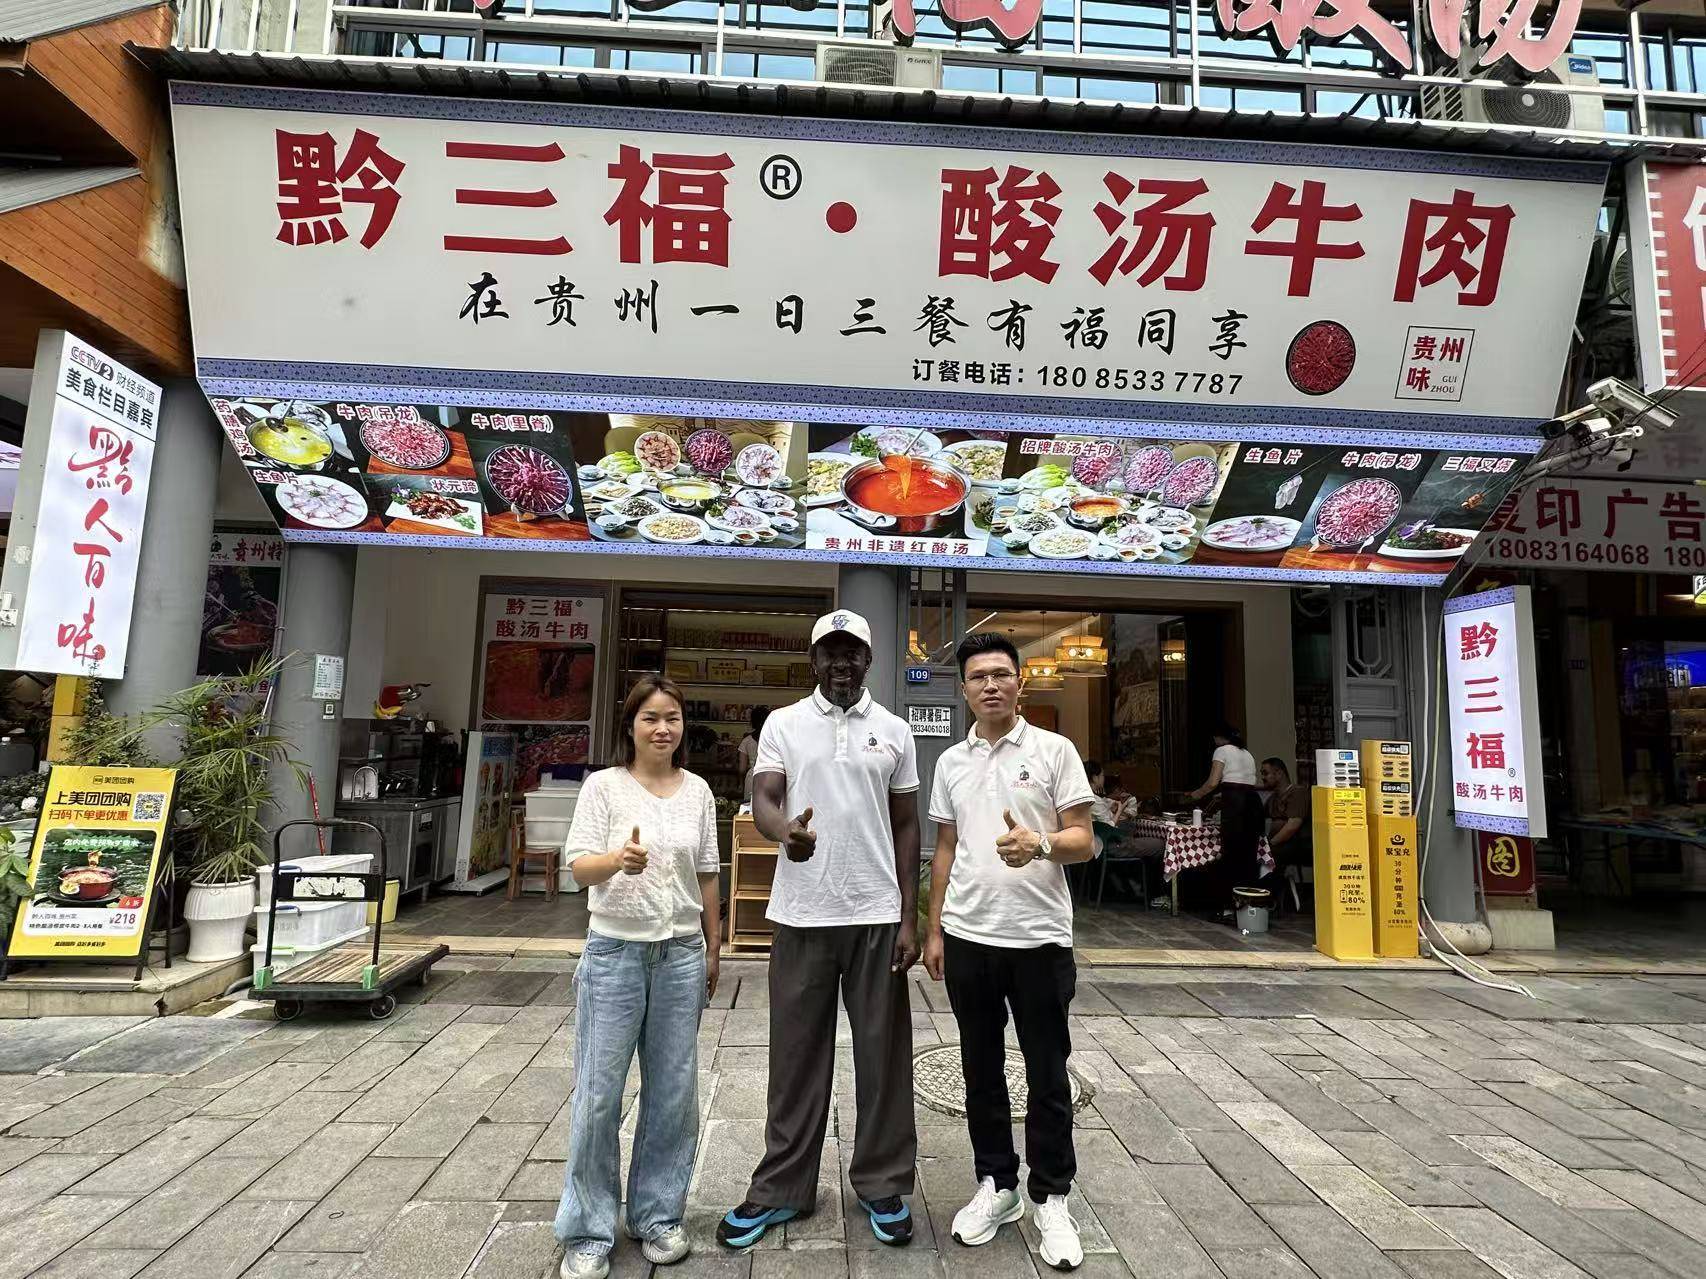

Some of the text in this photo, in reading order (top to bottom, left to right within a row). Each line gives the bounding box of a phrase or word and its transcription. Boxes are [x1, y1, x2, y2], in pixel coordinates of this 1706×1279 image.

[458, 271, 1249, 361] 在贵州一日三餐有福同享
[1411, 335, 1465, 362] 贵州
[116, 372, 156, 405] 财经频道
[1406, 367, 1431, 392] 味
[1442, 375, 1458, 383] GUI
[66, 367, 154, 430] 美食栏目嘉宾
[1430, 385, 1455, 393] ZHOU
[213, 398, 256, 456] 药膳鸡汤
[1020, 438, 1115, 458] 招牌酸汤牛肉
[1244, 447, 1304, 465] 生鱼片
[1441, 455, 1517, 474] 三福叉烧
[253, 469, 300, 485] 生鱼片
[431, 479, 479, 494] 状元蹄
[824, 536, 970, 555] 贵州非遗红酸汤
[495, 619, 589, 640] 酸汤牛肉
[910, 670, 928, 680] 109
[911, 707, 950, 722] 招聘暑假工
[51, 791, 131, 807] 上美团团购
[1456, 781, 1524, 803] 酸汤牛肉
[48, 809, 130, 821] 扫码下单更优惠
[1348, 896, 1366, 904] 80%
